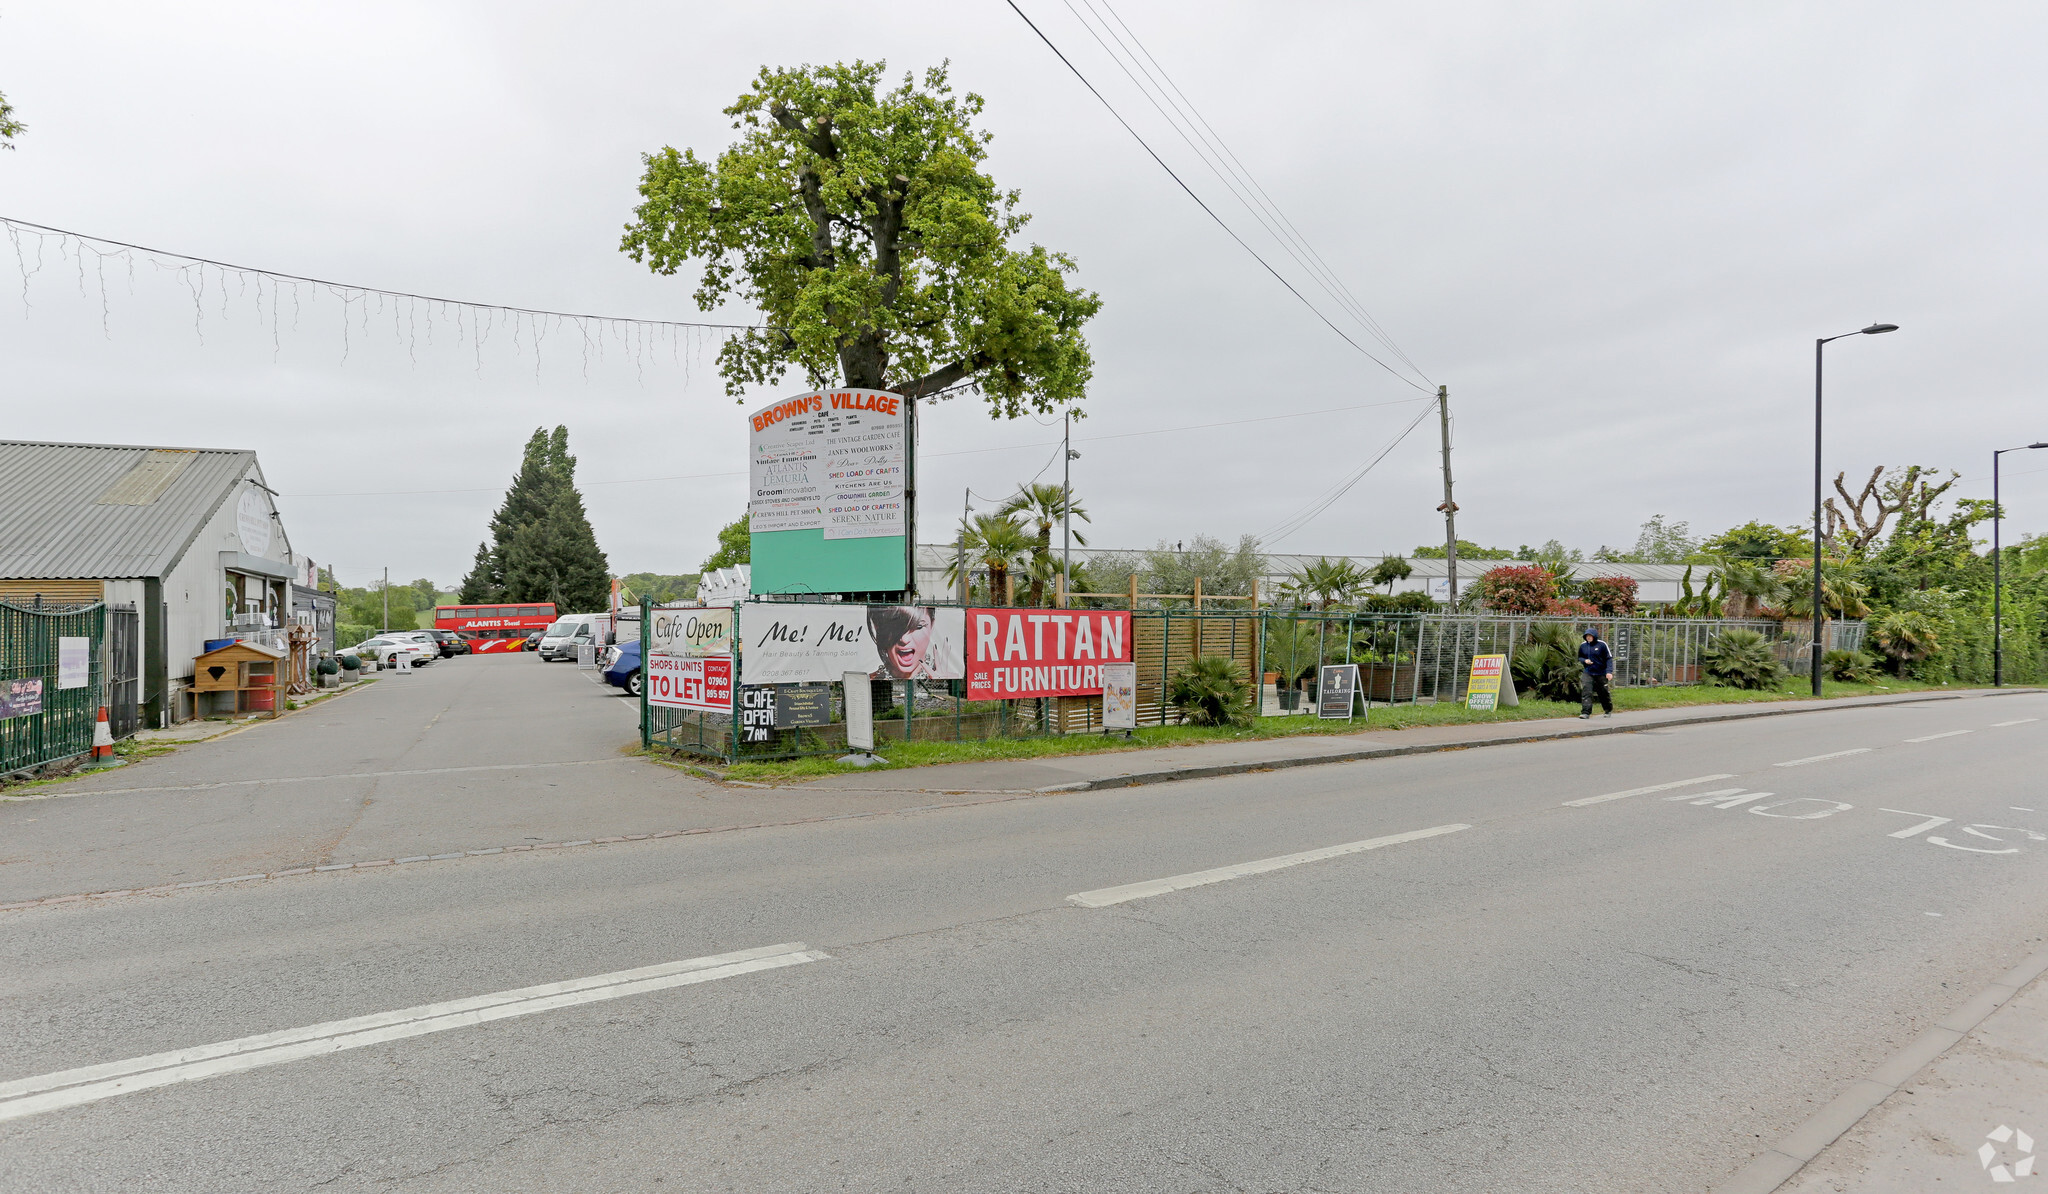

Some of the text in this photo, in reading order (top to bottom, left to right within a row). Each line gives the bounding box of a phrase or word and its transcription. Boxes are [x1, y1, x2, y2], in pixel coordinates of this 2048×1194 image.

[753, 393, 900, 432] BROWN'S VILLAGE
[838, 435, 861, 443] VINTAGE
[862, 433, 885, 442] GARDEN
[828, 448, 848, 456] JANE'S
[851, 444, 894, 454] WOOLWORKS
[766, 462, 808, 475] ATLANTIS
[846, 470, 864, 478] LOAD
[764, 473, 809, 486] LEMURIA
[828, 506, 842, 514] SHED
[872, 502, 900, 510] CRAFTERS
[832, 512, 896, 524] SERENE NATURE
[466, 620, 501, 628] ALANTIS
[656, 615, 722, 646] Cafe Open
[758, 621, 863, 648] Me! Me!
[976, 614, 1123, 662] RATTAN
[780, 650, 804, 658] Beauty
[812, 650, 838, 658] Tanning
[650, 660, 702, 672] SHOPS & UNITS
[1474, 658, 1502, 668] RATTAN
[708, 676, 728, 686] 07960
[974, 672, 988, 680] SALE
[650, 675, 702, 700] TO LET
[971, 681, 991, 689] PRICES
[706, 689, 730, 700] 895 957
[744, 710, 774, 726] OPEN
